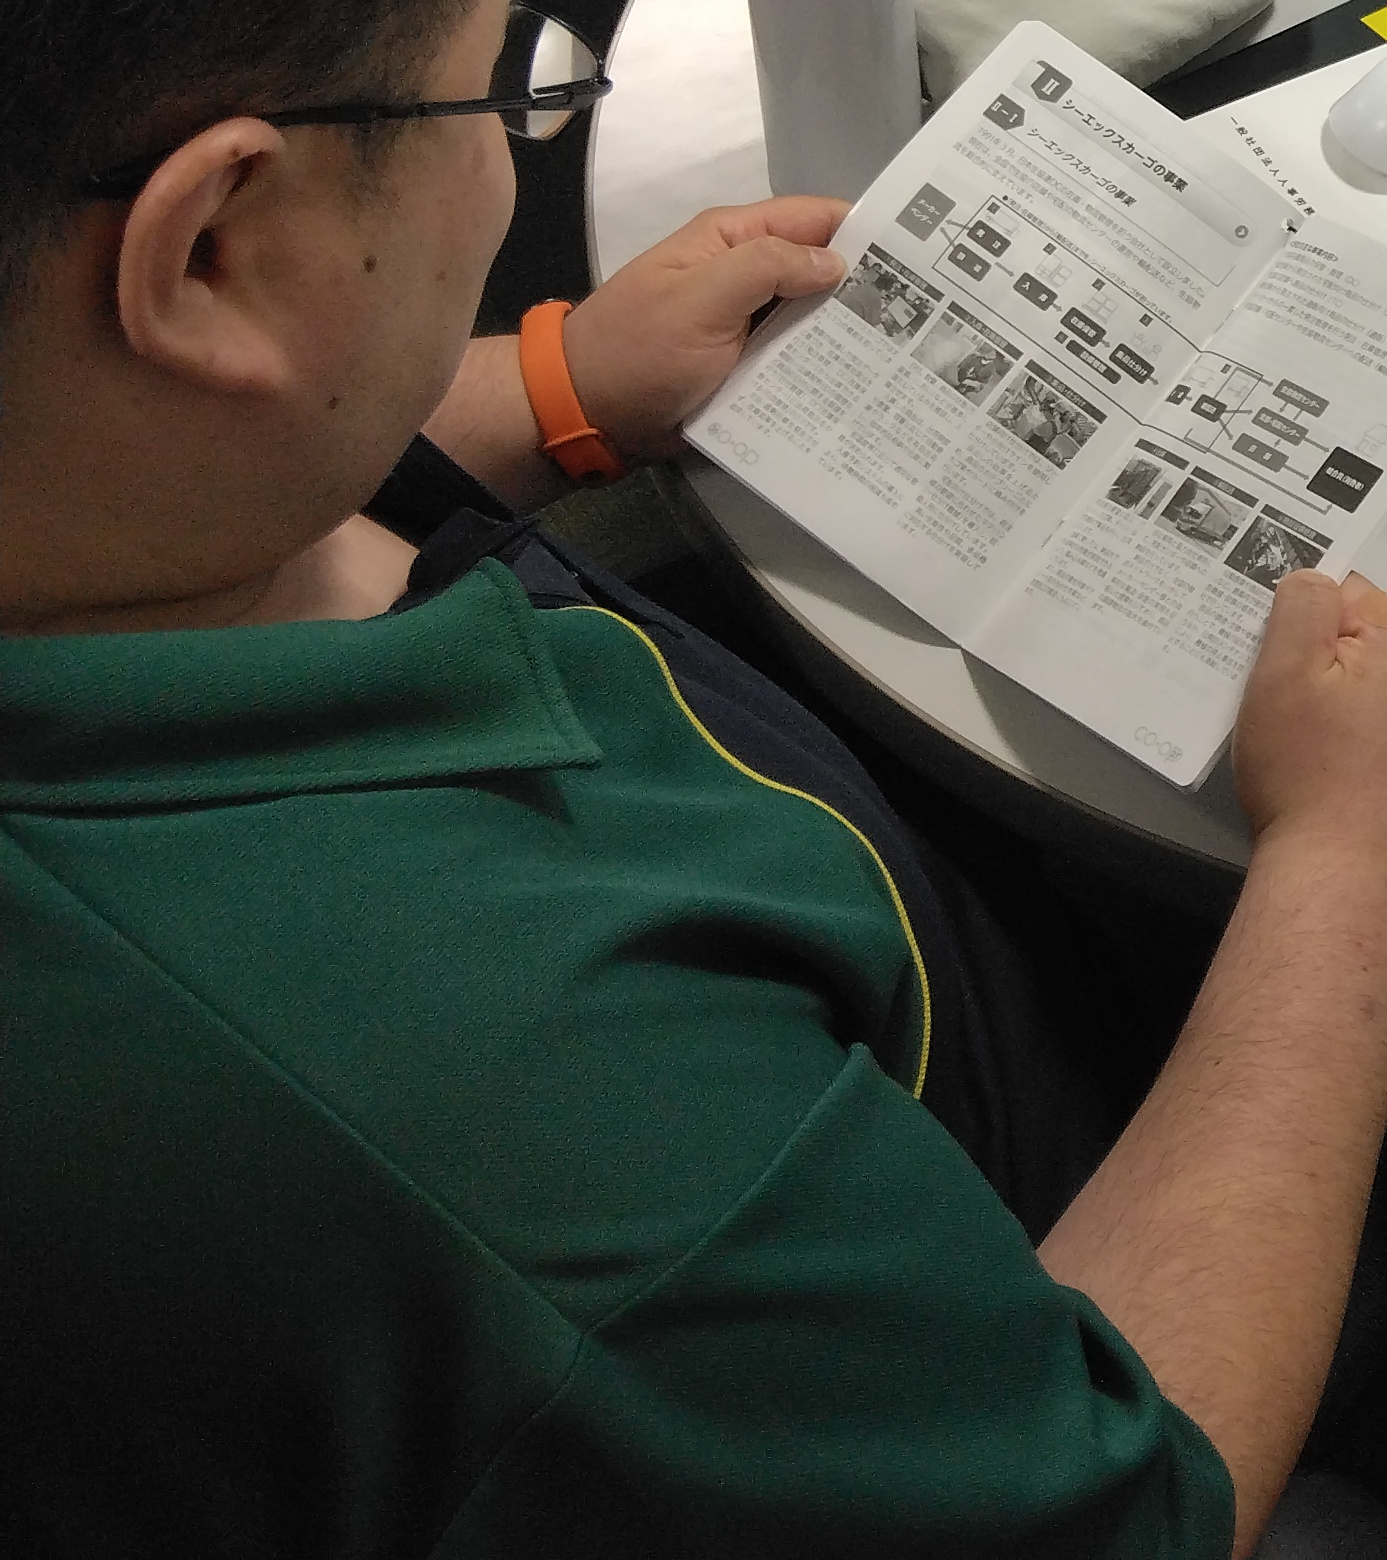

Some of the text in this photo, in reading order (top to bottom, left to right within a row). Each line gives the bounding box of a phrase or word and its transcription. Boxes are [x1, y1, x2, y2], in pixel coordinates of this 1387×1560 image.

[1026, 125, 1137, 209] シーエックスカーゴの事業
[1060, 97, 1189, 194] シーエックスカーゴの事業
